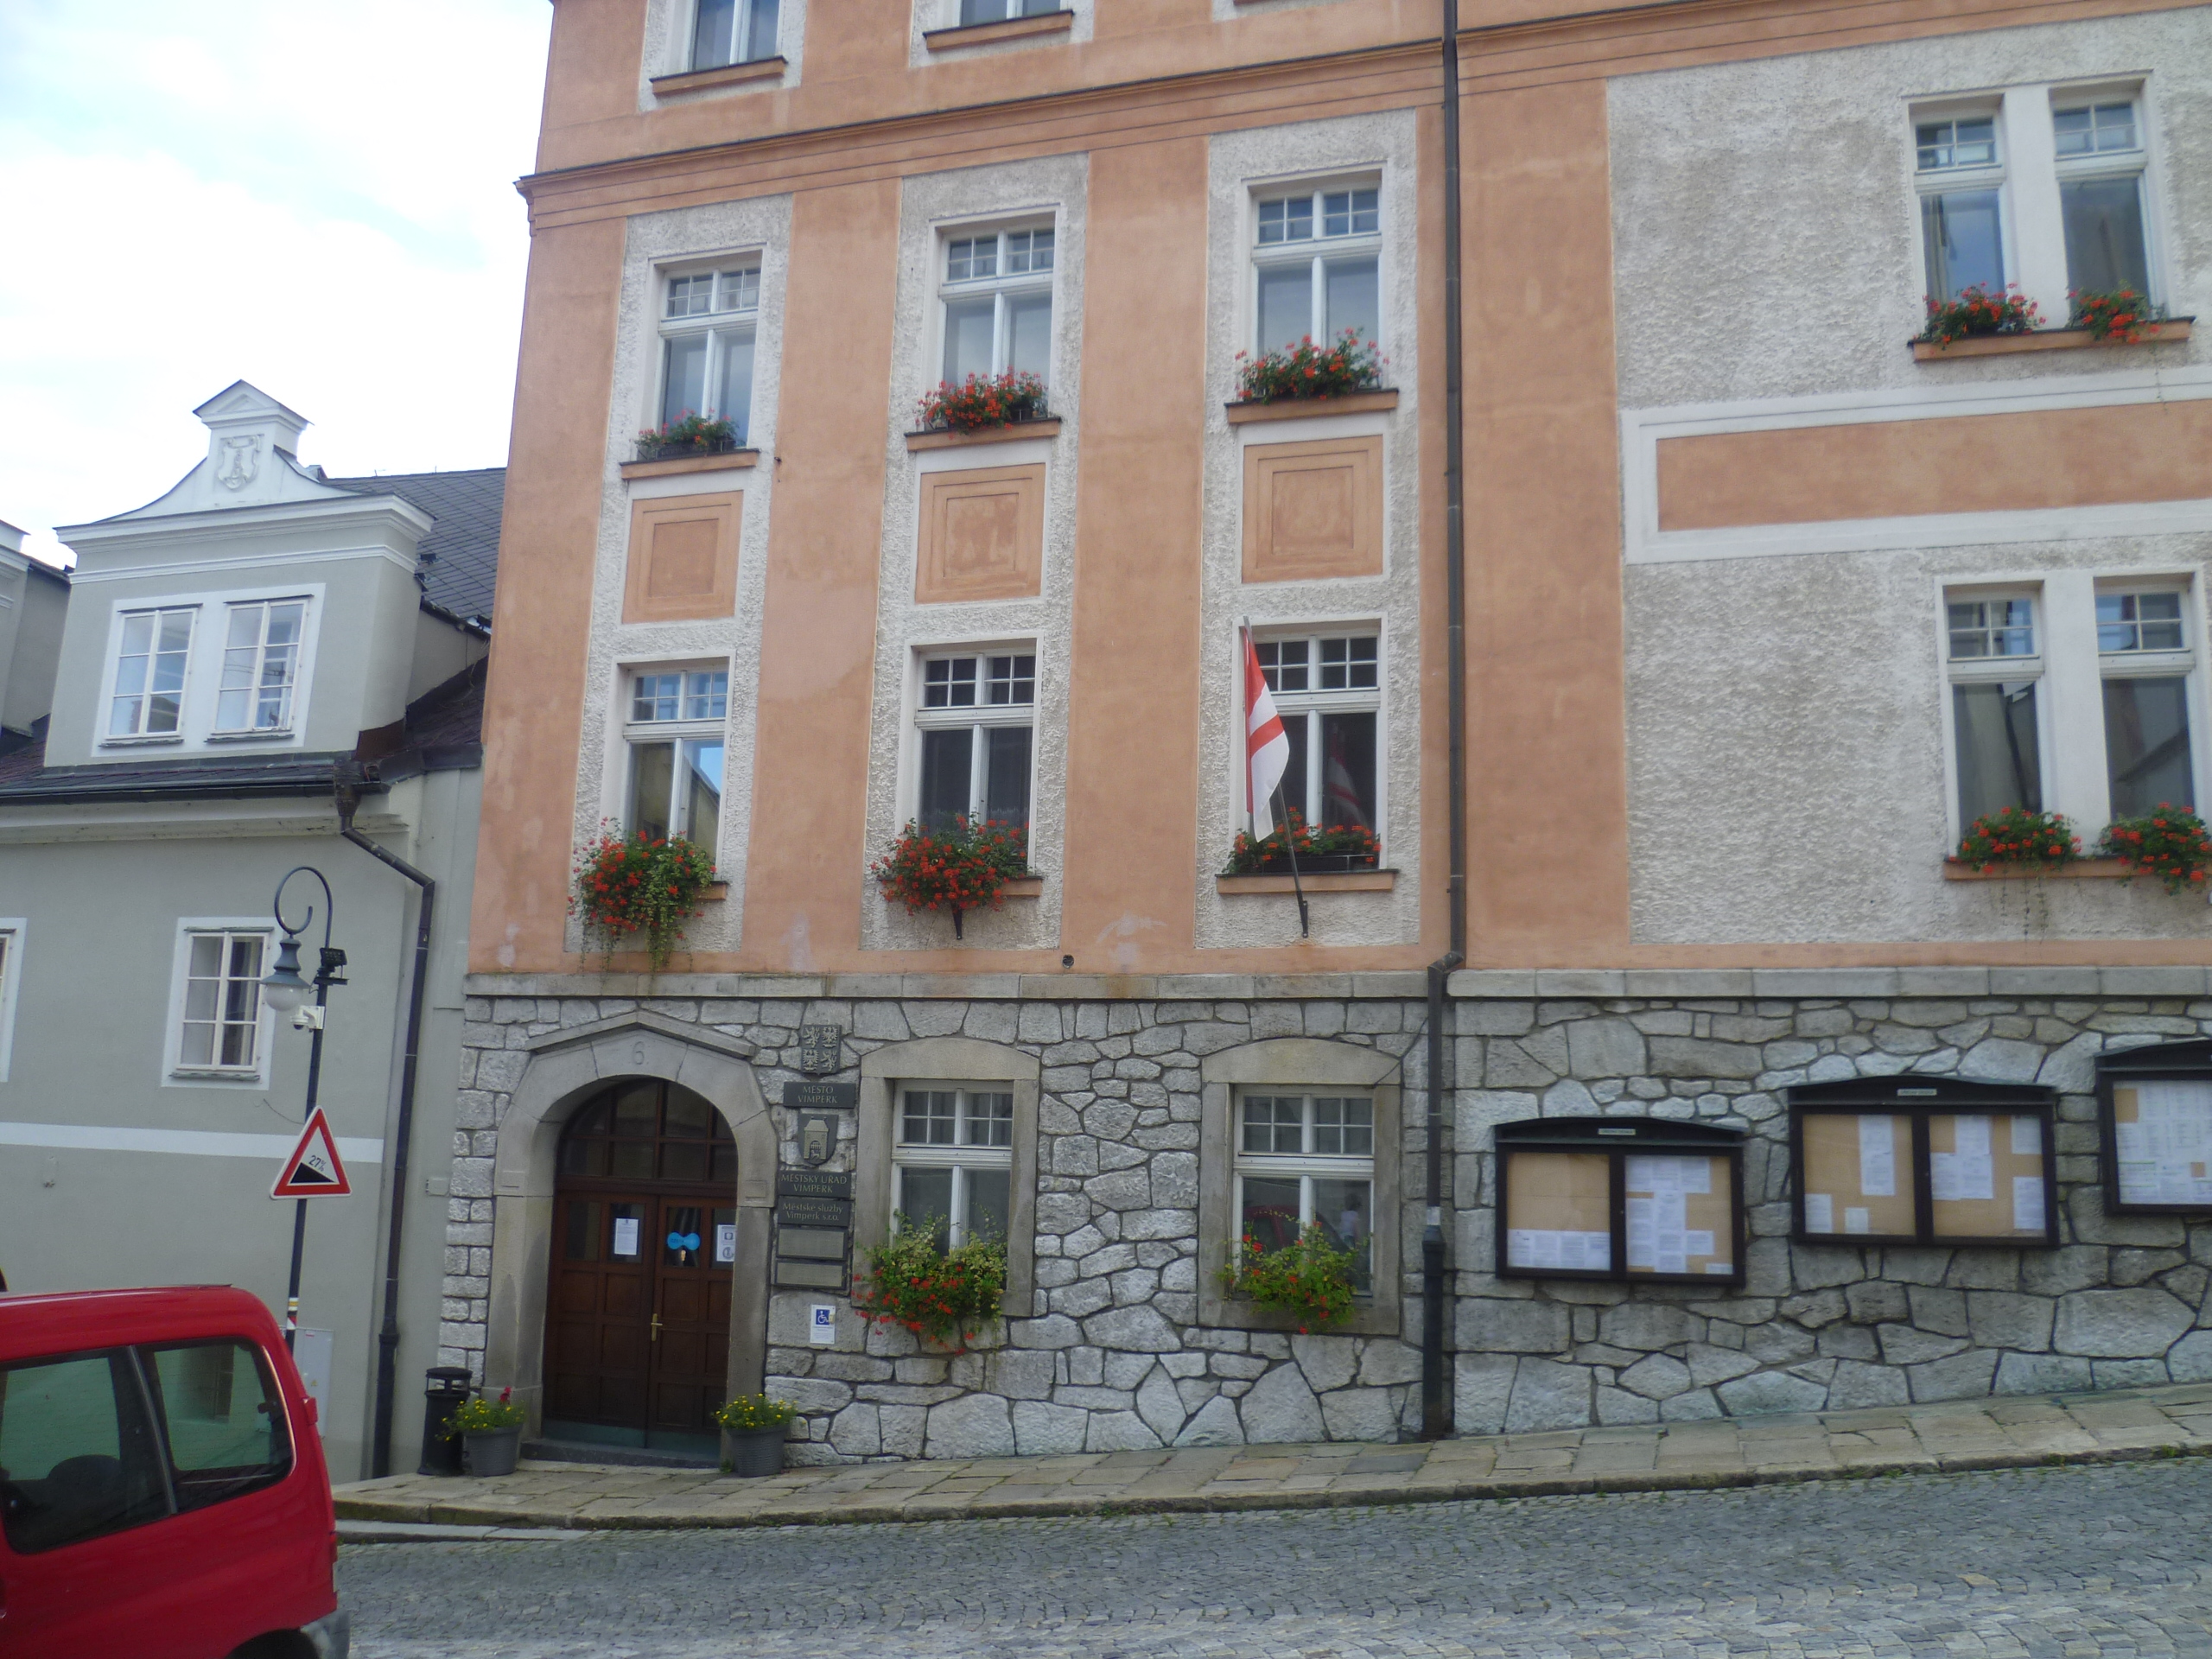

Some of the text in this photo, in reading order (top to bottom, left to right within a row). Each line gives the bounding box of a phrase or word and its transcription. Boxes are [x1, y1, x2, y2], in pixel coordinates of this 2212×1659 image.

[632, 1040, 645, 1065] 6
[798, 1095, 838, 1103] VIMPERK
[308, 1154, 327, 1172] 27%
[793, 1184, 833, 1193] VIMPERK
[786, 1211, 820, 1221] Vimperk
